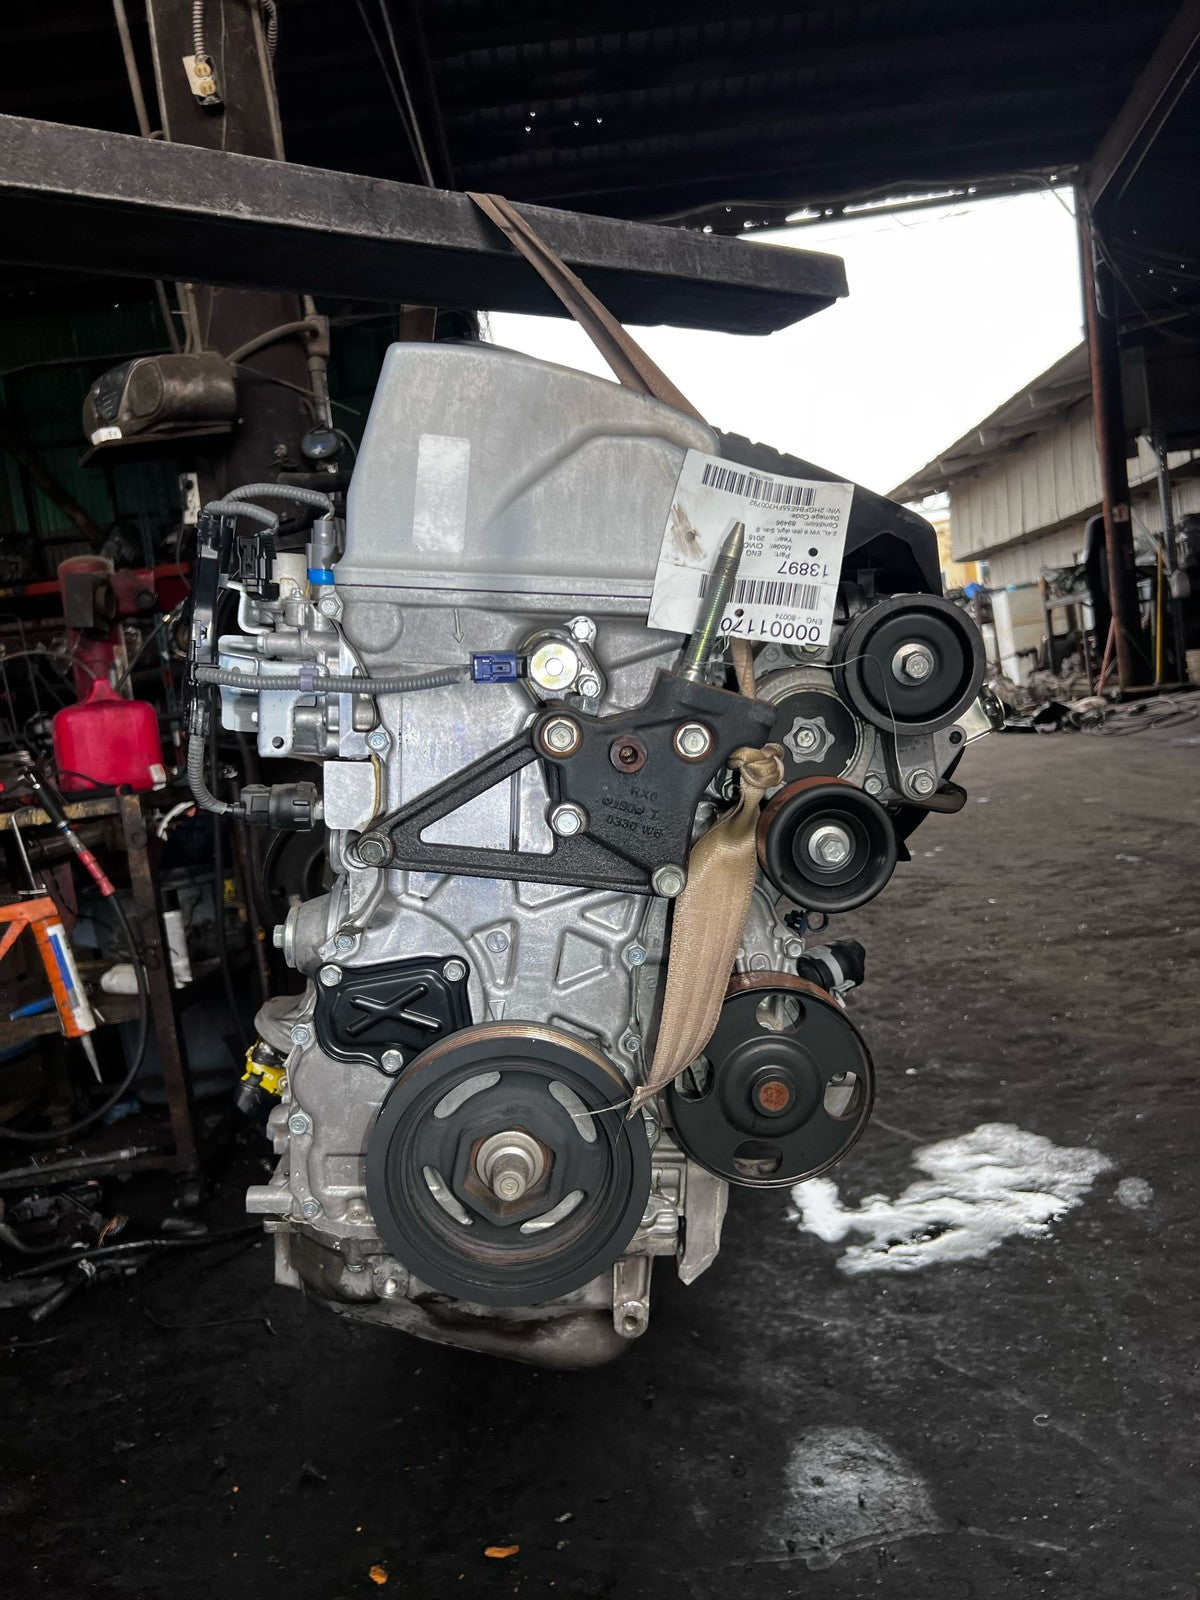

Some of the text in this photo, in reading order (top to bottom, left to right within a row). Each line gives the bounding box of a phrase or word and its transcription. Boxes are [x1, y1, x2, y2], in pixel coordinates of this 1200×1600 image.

[769, 543, 792, 551] Model:
[777, 561, 829, 578] 13897
[805, 617, 823, 625] ENG
[720, 617, 820, 642] 00001170
